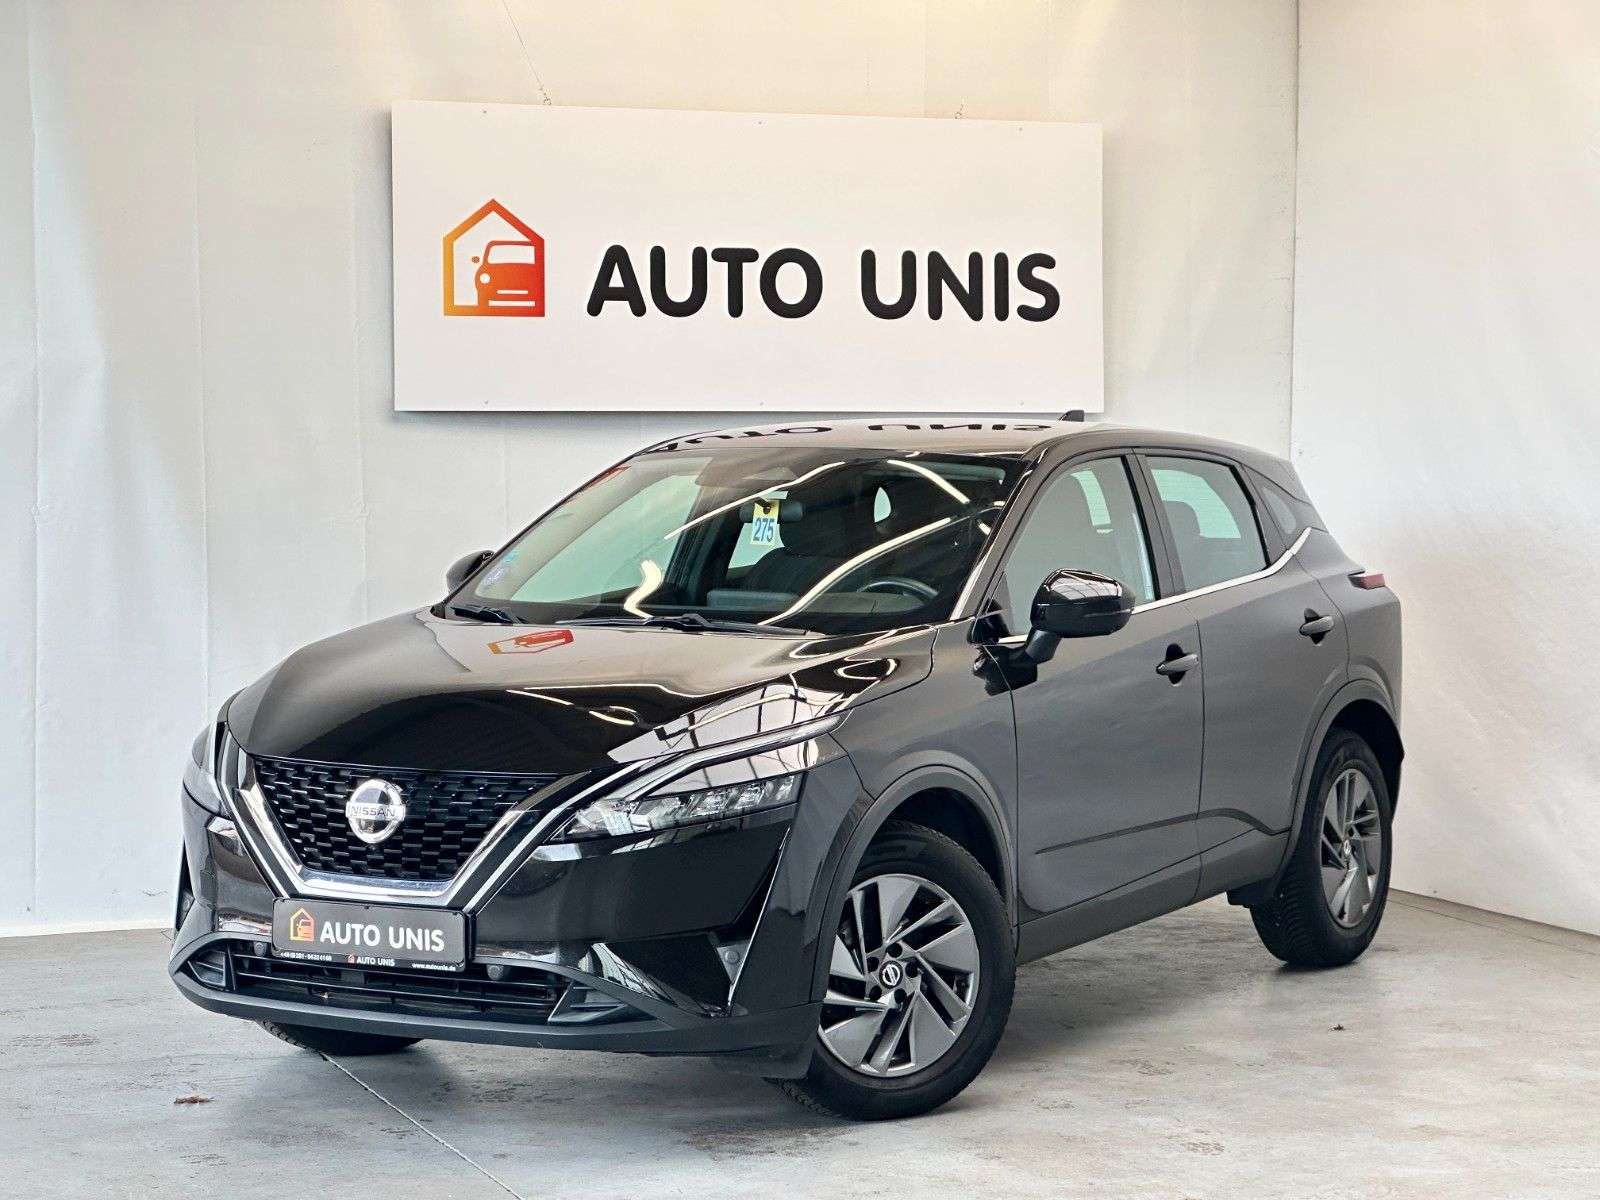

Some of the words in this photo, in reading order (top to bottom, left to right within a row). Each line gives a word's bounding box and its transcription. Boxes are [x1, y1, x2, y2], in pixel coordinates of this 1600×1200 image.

[587, 244, 823, 318] AUTO
[860, 248, 1061, 322] UNIS
[752, 517, 776, 542] 275
[350, 804, 396, 817] NISSAN
[319, 921, 381, 947] AUTO
[388, 926, 445, 952] UNIS
[356, 956, 376, 966] AUTO
[377, 957, 396, 967] UNIS
